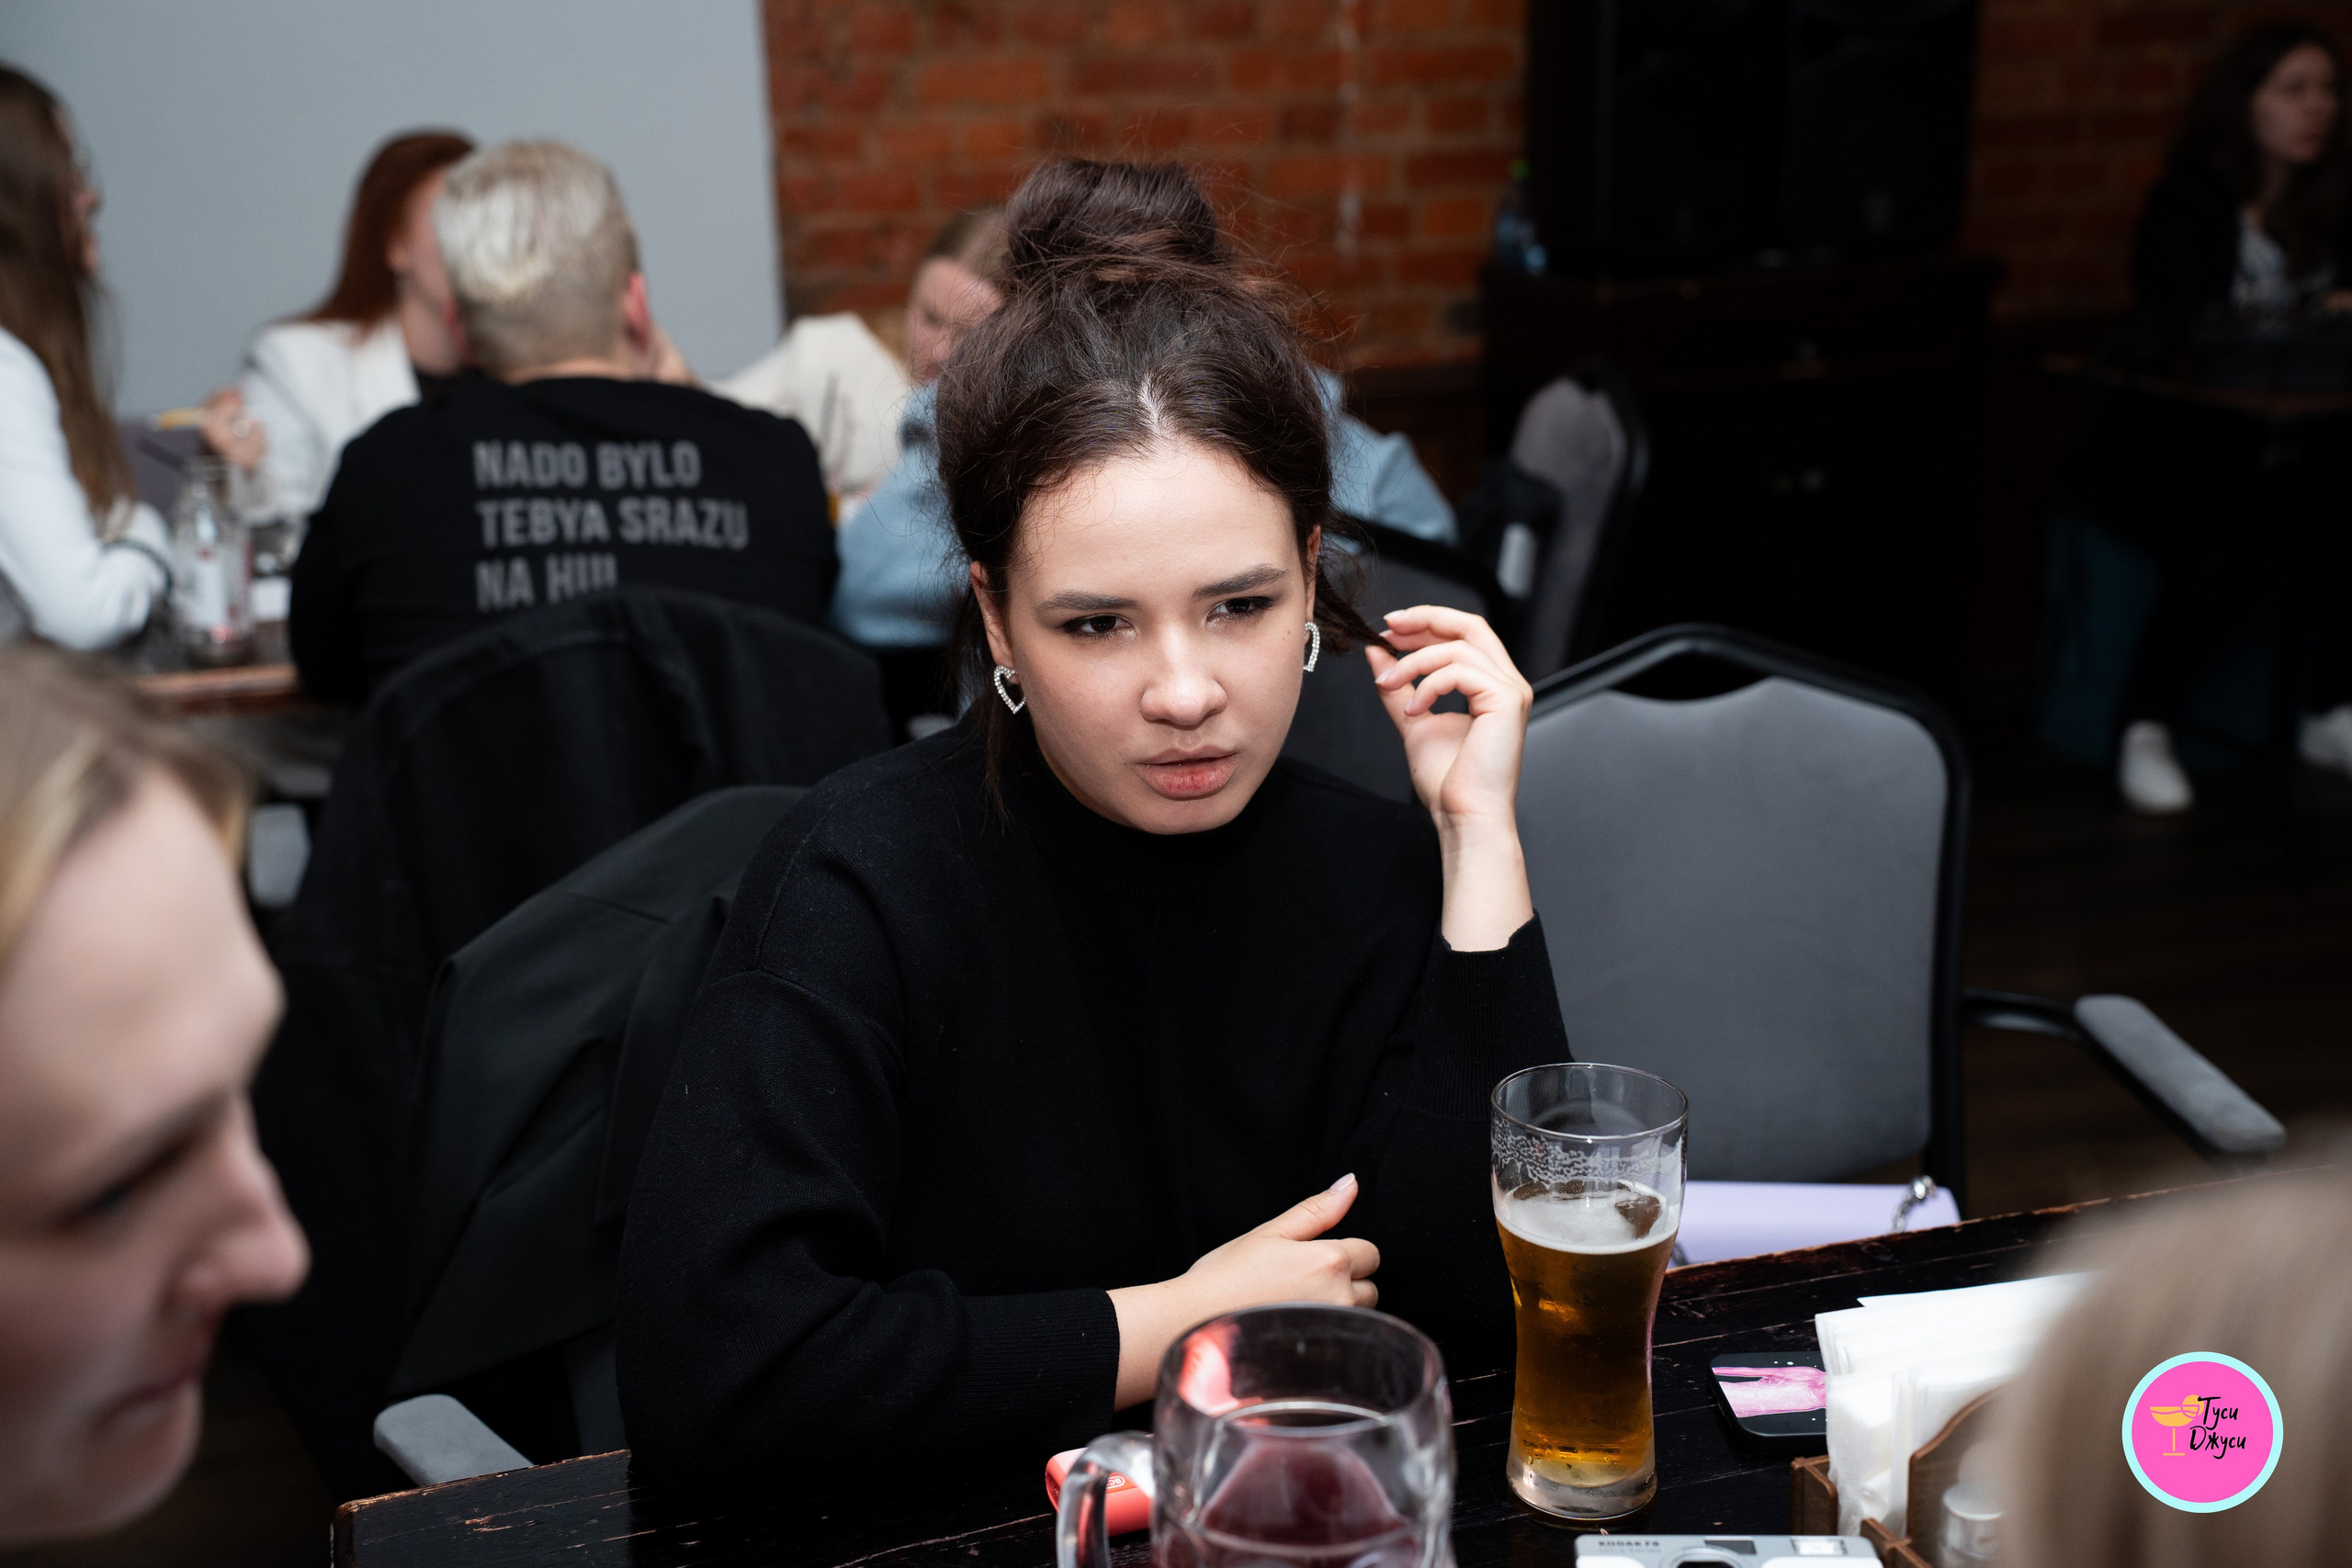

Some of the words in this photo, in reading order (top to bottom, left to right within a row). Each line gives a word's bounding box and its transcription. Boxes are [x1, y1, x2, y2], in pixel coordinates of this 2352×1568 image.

[473, 441, 588, 489] NADO
[597, 441, 702, 489] BYLO
[477, 500, 611, 547] TEBYA
[617, 497, 749, 549] SRAZU
[476, 557, 536, 612] NA
